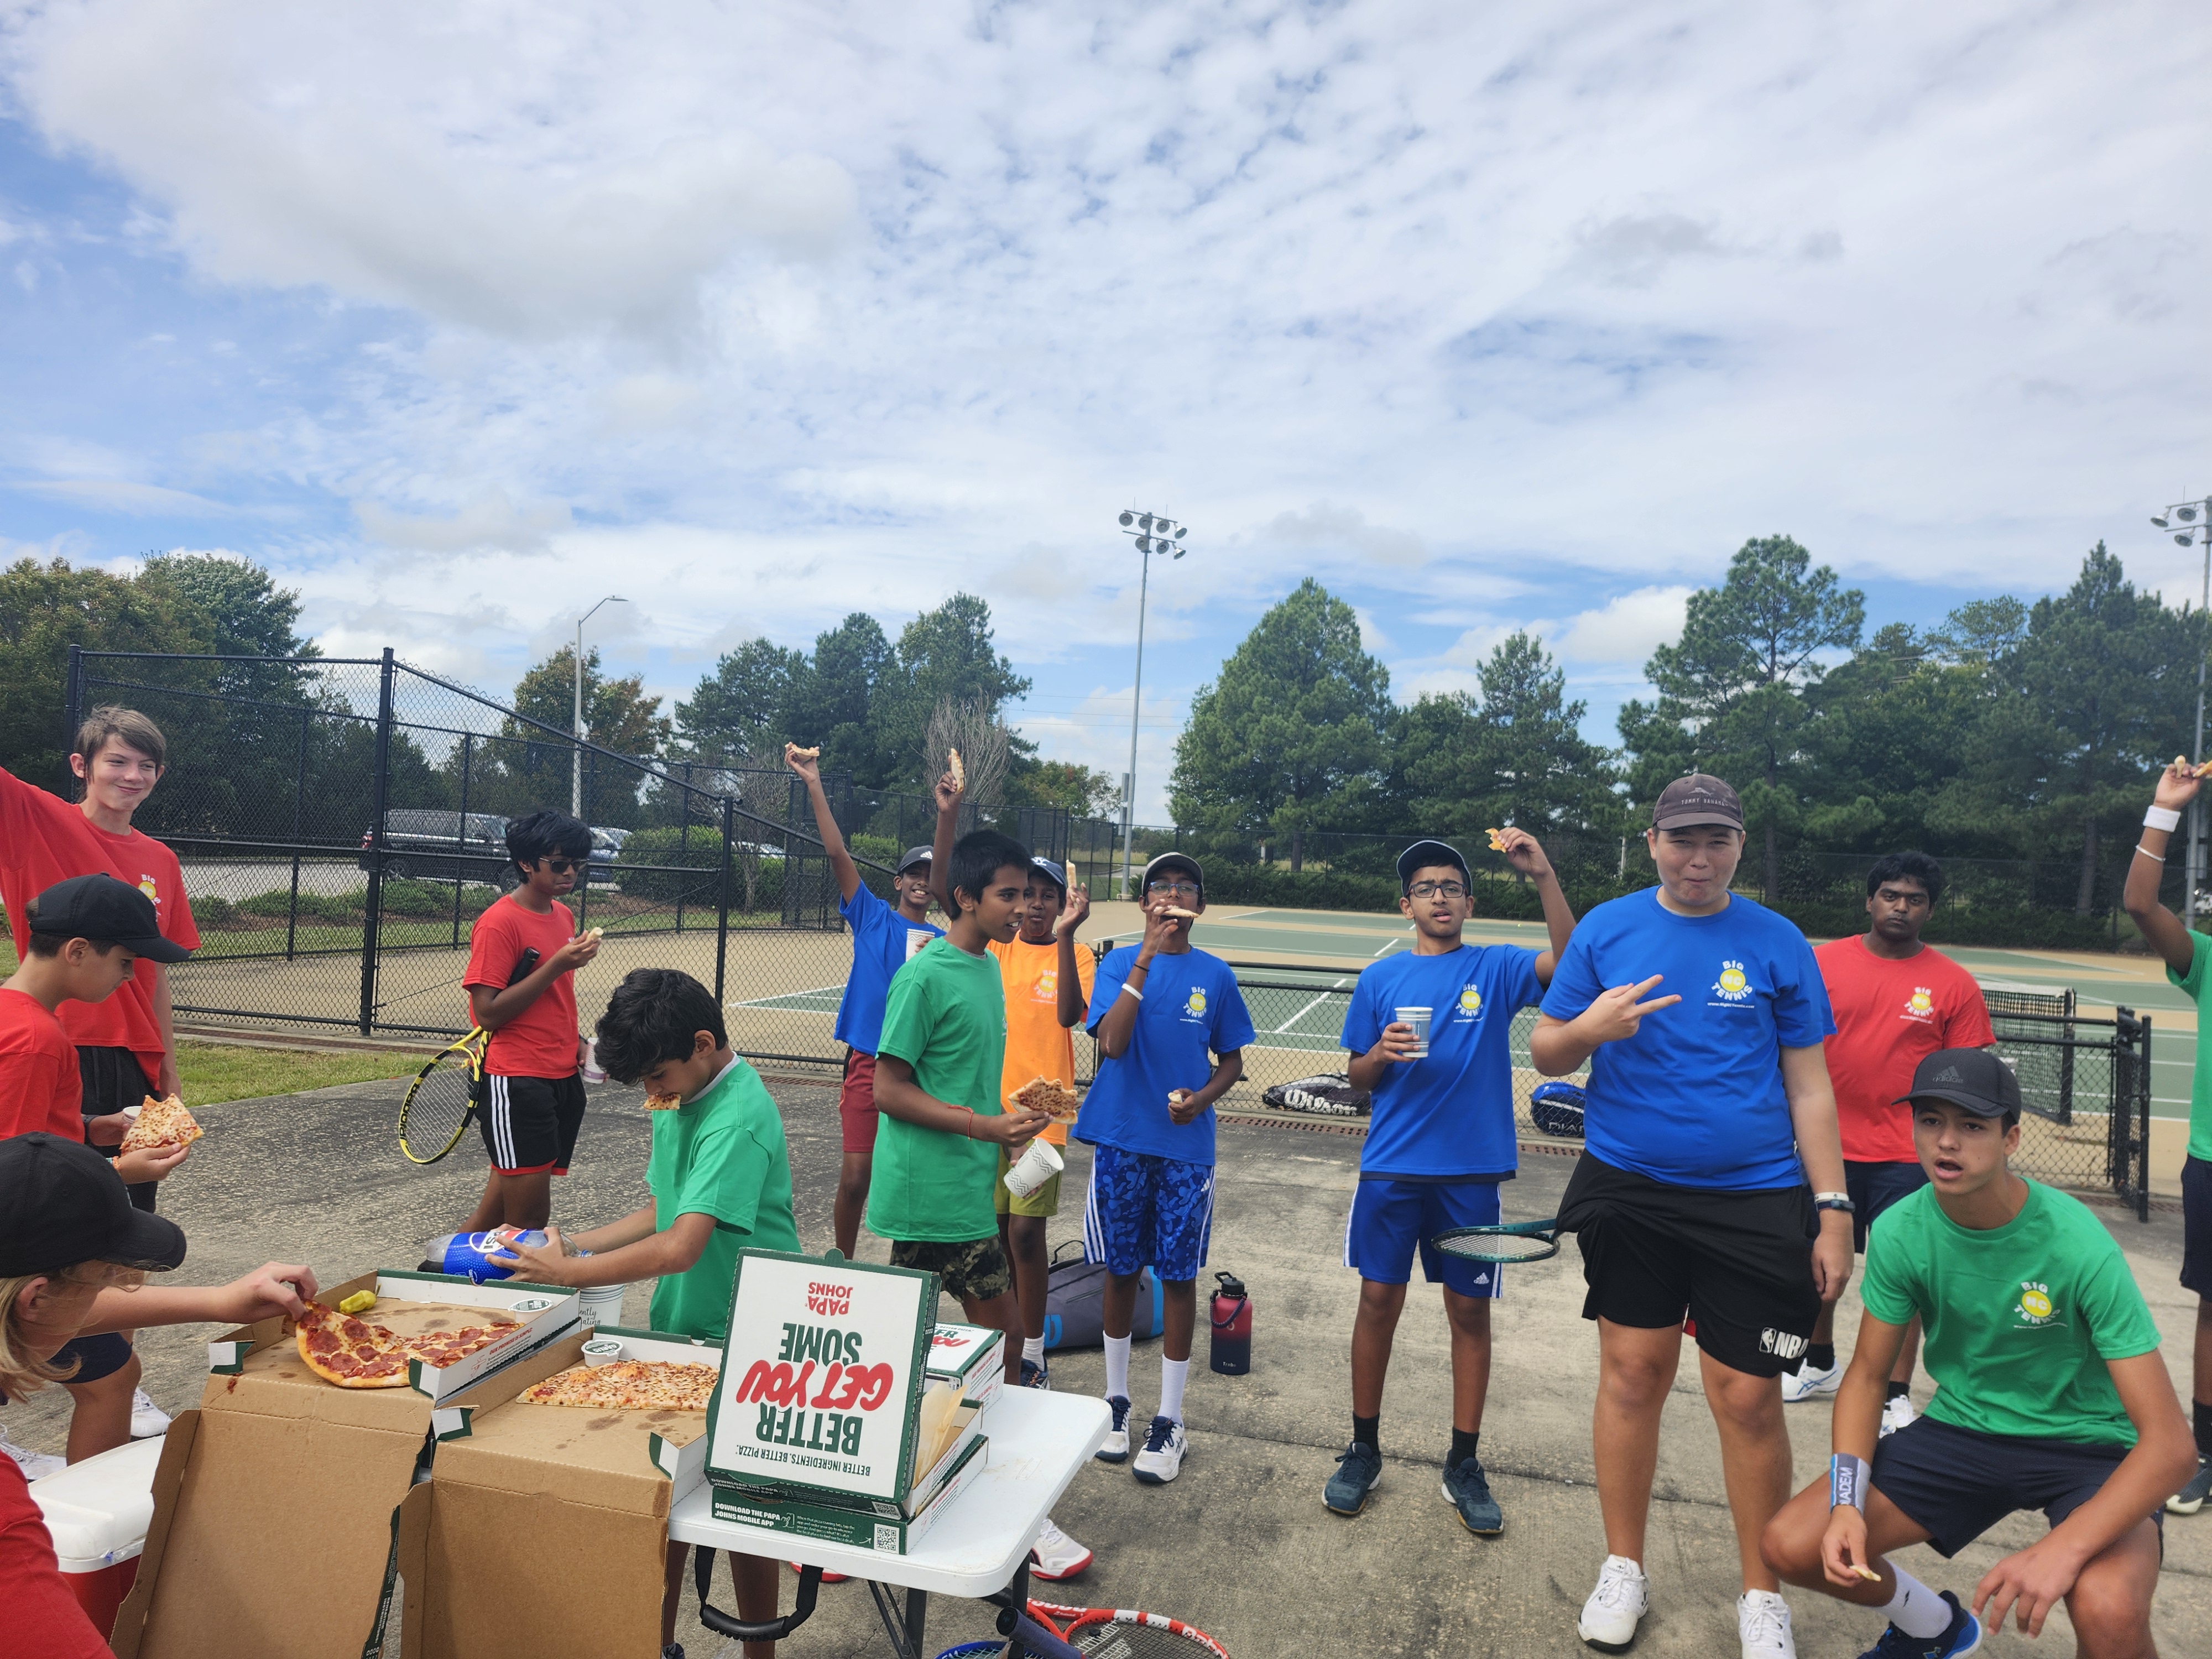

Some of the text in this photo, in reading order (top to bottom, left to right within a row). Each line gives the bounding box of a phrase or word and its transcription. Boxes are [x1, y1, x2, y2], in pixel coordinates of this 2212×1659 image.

[1703, 798, 1725, 807] BAHAMA
[141, 874, 156, 885] BIG
[1722, 959, 1744, 971] BIG
[1042, 969, 1057, 978] BIG
[1723, 974, 1743, 987] NC
[1191, 987, 1206, 995] BIG
[1463, 983, 1477, 992] BIG
[1711, 982, 1753, 1001] TENNIS
[1914, 987, 1932, 997] BIG
[1192, 997, 1203, 1007] NC
[1463, 995, 1477, 1005] NC
[1183, 1003, 1207, 1018] TENNIS
[1903, 1001, 1934, 1017] TENNIS
[808, 1282, 853, 1299] JOHNS
[2021, 1281, 2048, 1294] BIG
[808, 1296, 850, 1316] PAPA
[2025, 1295, 2048, 1311] NC
[579, 1307, 597, 1320] ently
[2013, 1304, 2061, 1324] TENNIS
[778, 1322, 862, 1367] SOME
[932, 1335, 971, 1348] OU
[1773, 1331, 1809, 1359] NBA
[736, 1360, 893, 1411] GET YOU
[756, 1401, 863, 1457] BETTER
[761, 1449, 788, 1463] BETTER
[789, 1453, 841, 1472] INGREDIENTS.
[842, 1463, 871, 1477] BETTER
[711, 1478, 748, 1488] DOWNLOAD
[1839, 1467, 1853, 1505] IADEM
[714, 1503, 780, 1521] DOWNLOAD THE PAPA
[714, 1510, 737, 1520] JOHNS
[737, 1514, 761, 1525] MOBILE
